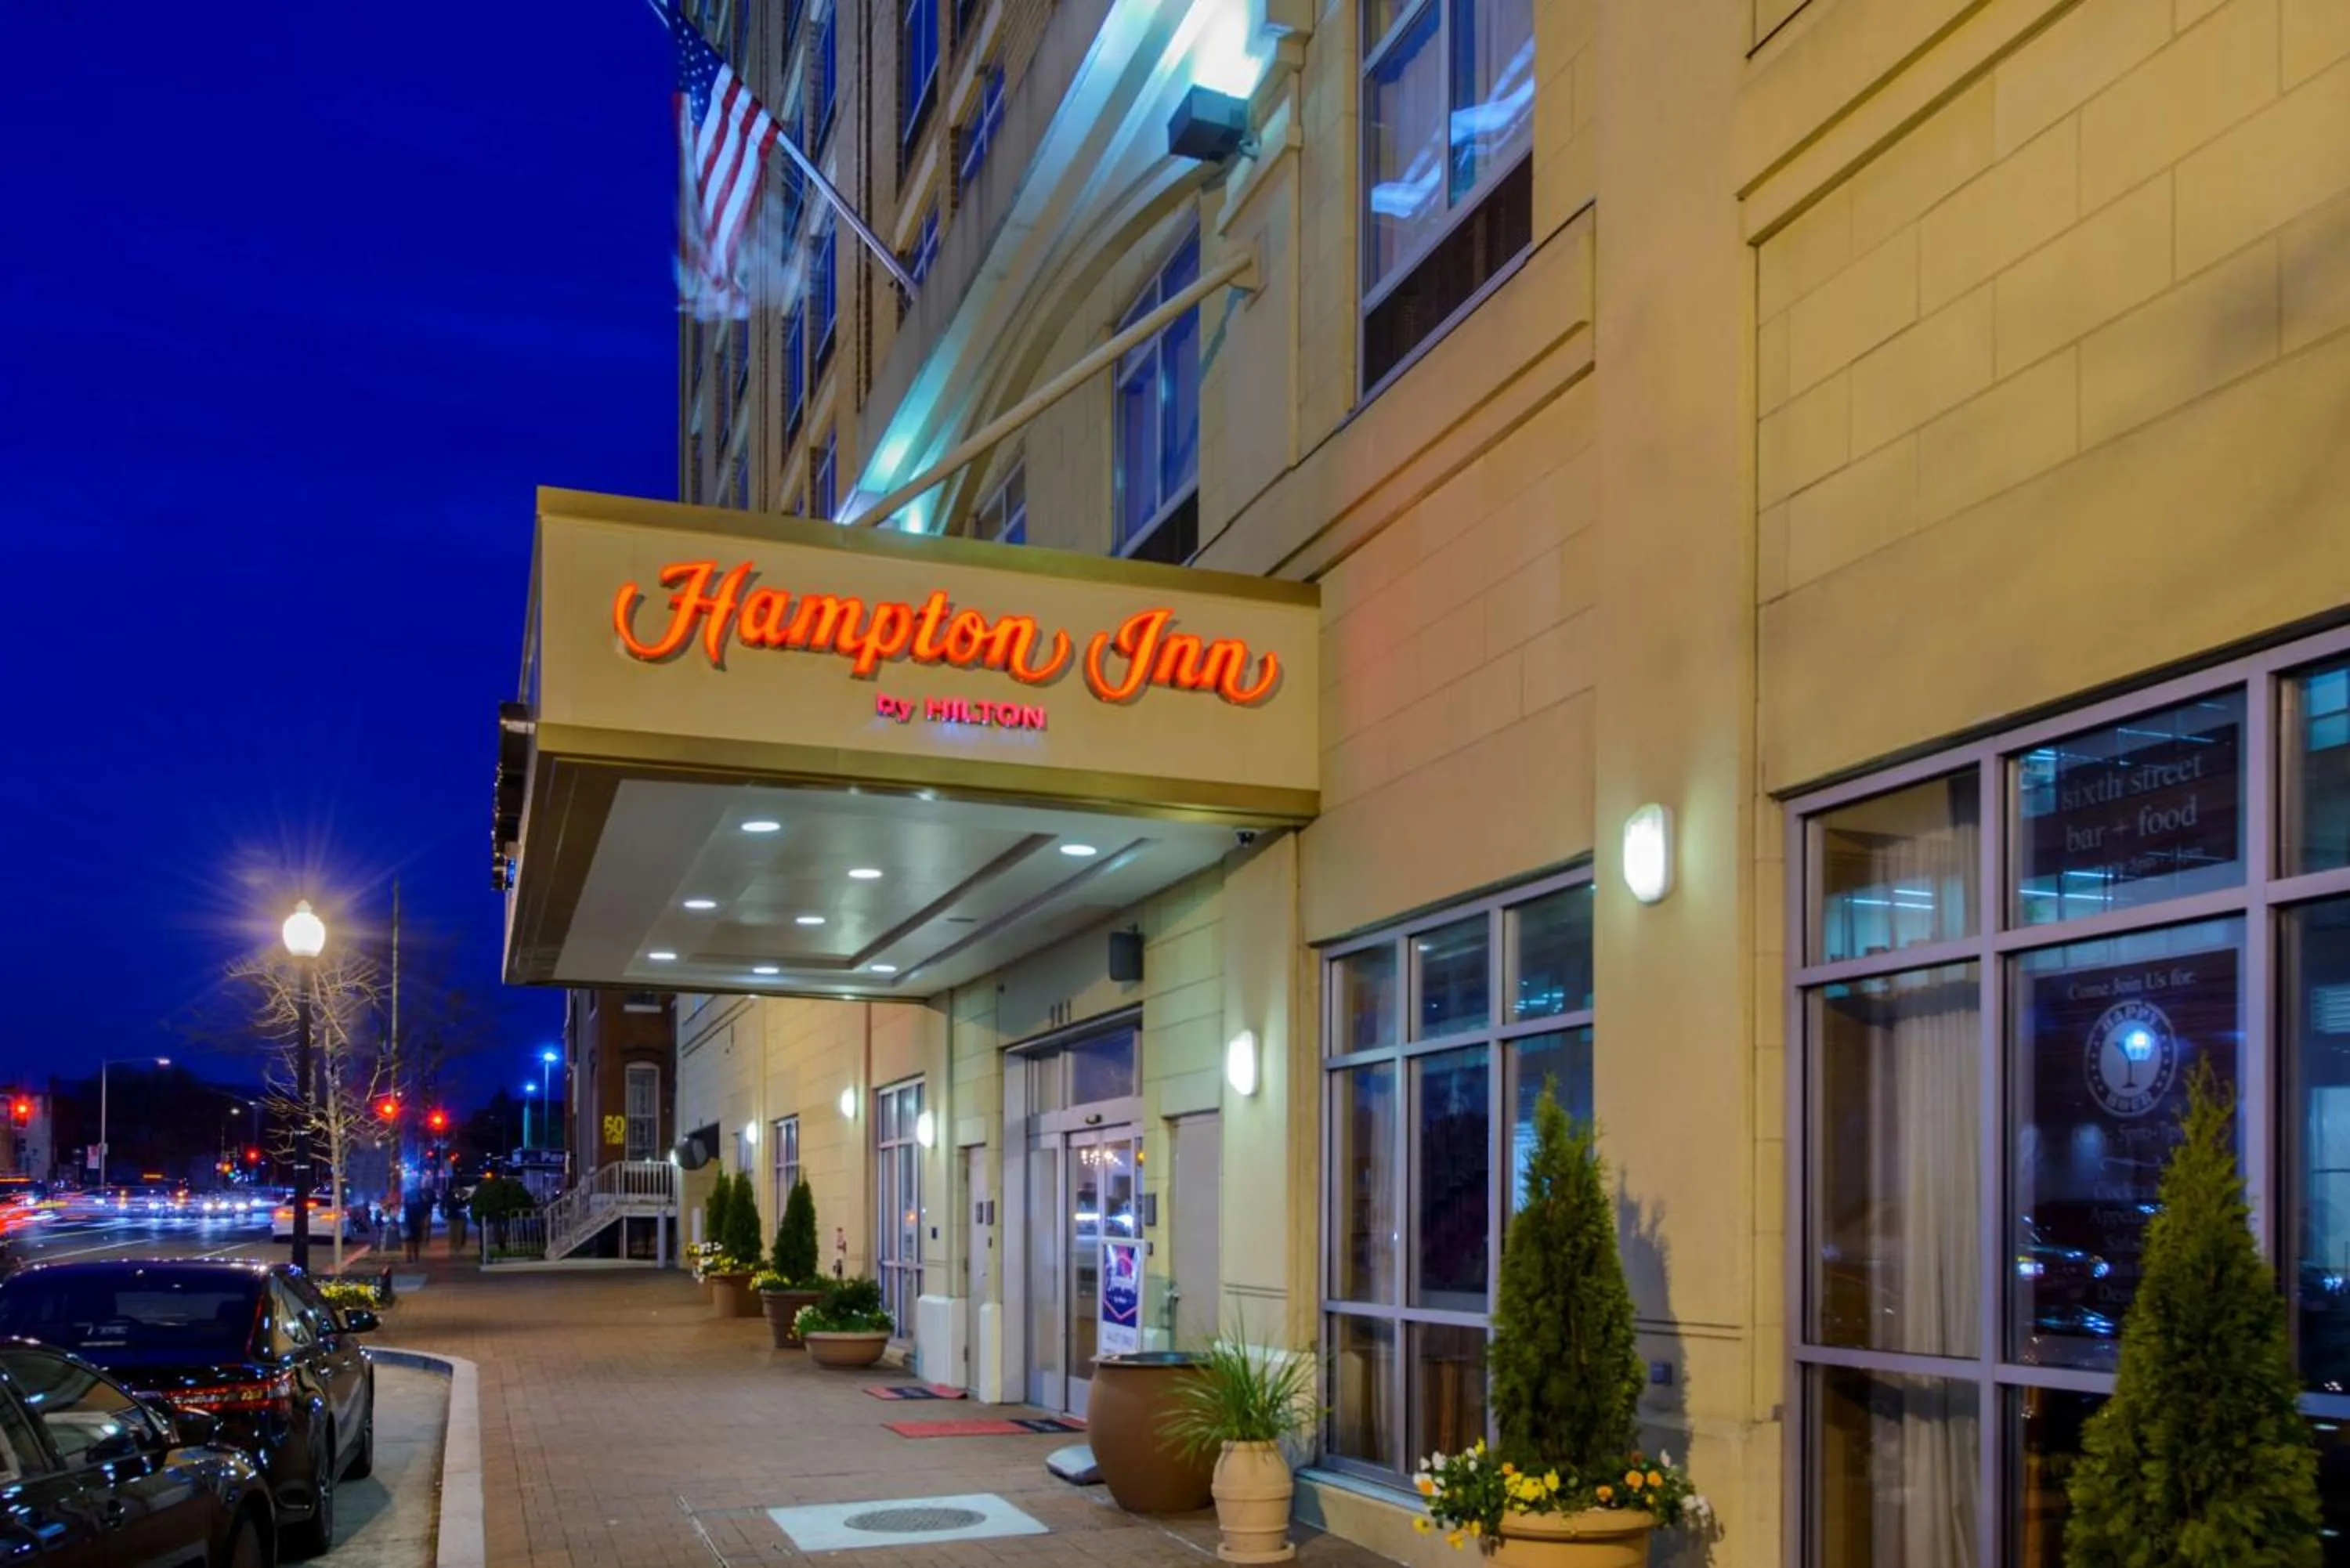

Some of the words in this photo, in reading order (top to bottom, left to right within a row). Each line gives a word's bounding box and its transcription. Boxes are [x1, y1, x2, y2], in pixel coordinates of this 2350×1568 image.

[613, 560, 1071, 685] Hampton
[1086, 607, 1280, 704] Inn
[876, 689, 915, 723] by
[925, 694, 1047, 729] HILTON
[2061, 771, 2123, 811] sixth
[2130, 754, 2202, 792] street
[2065, 824, 2107, 853] bar
[2138, 794, 2198, 836] food
[2145, 971, 2167, 990] Us
